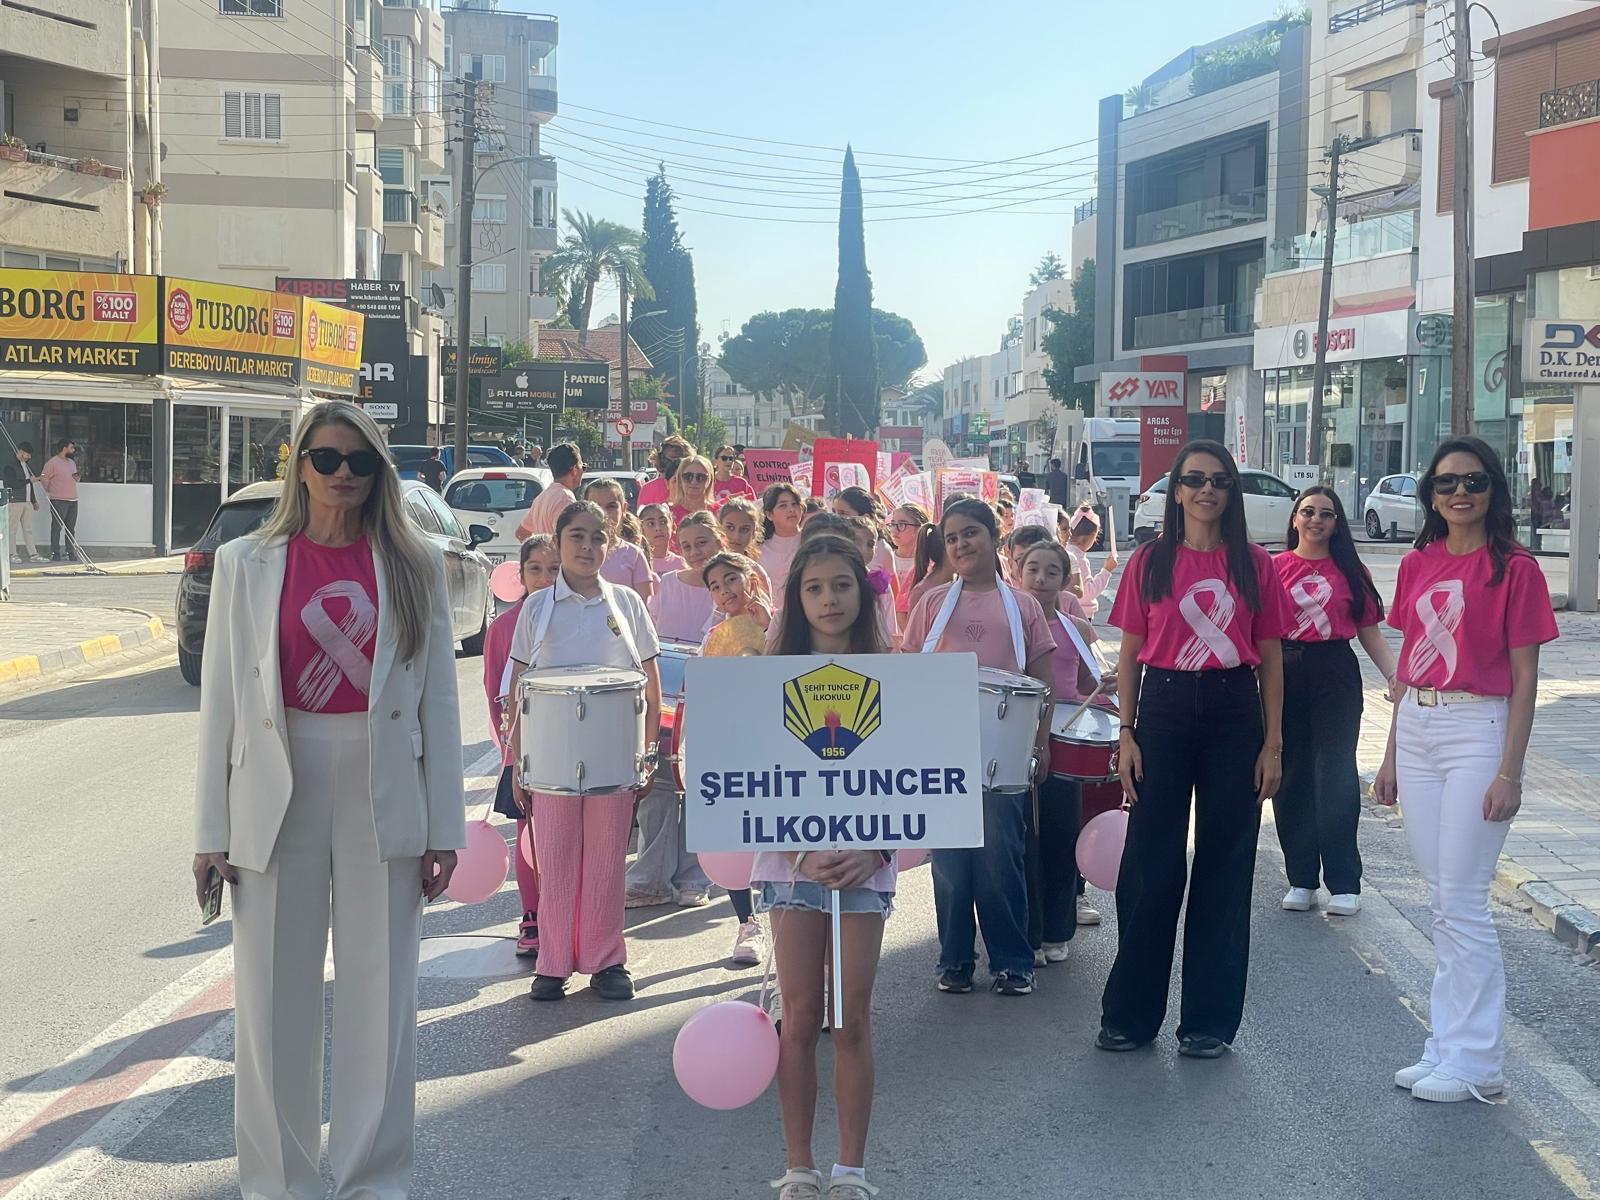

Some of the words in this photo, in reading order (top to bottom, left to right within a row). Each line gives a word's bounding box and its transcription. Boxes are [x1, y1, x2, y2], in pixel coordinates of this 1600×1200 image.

[276, 281, 347, 298] KIBRIS
[351, 282, 382, 291] HABER
[389, 283, 400, 292] TV
[0, 287, 86, 321] BORG
[96, 295, 133, 312] %100
[102, 310, 130, 319] MALT
[196, 298, 269, 336] TUBORG
[274, 312, 294, 328] %100
[276, 327, 292, 336] MALT
[319, 319, 347, 351] TUBORG
[5, 345, 63, 363] ATLAR
[67, 346, 140, 366] MARKET
[1540, 351, 1572, 366] D.K.
[170, 350, 222, 371] DEREBOYU
[224, 356, 254, 375] ATLAR
[256, 360, 294, 378] MARKET
[570, 375, 606, 384] PATRIC
[1540, 369, 1589, 378] Chartered
[1145, 380, 1179, 399] YAR
[537, 402, 558, 411] dyson
[1147, 417, 1170, 425] ARGAS
[753, 460, 790, 469] KONTRO
[1294, 471, 1304, 479] LTB
[1306, 471, 1314, 479] SU
[804, 683, 825, 693] ŞEHİT
[827, 683, 860, 692] TUNCER
[813, 692, 851, 701] İLKOKULU
[821, 747, 846, 757] 1956
[700, 764, 807, 806] ŞEHİT
[818, 767, 968, 797] TUNCER
[742, 810, 927, 844] İLKOKULU
